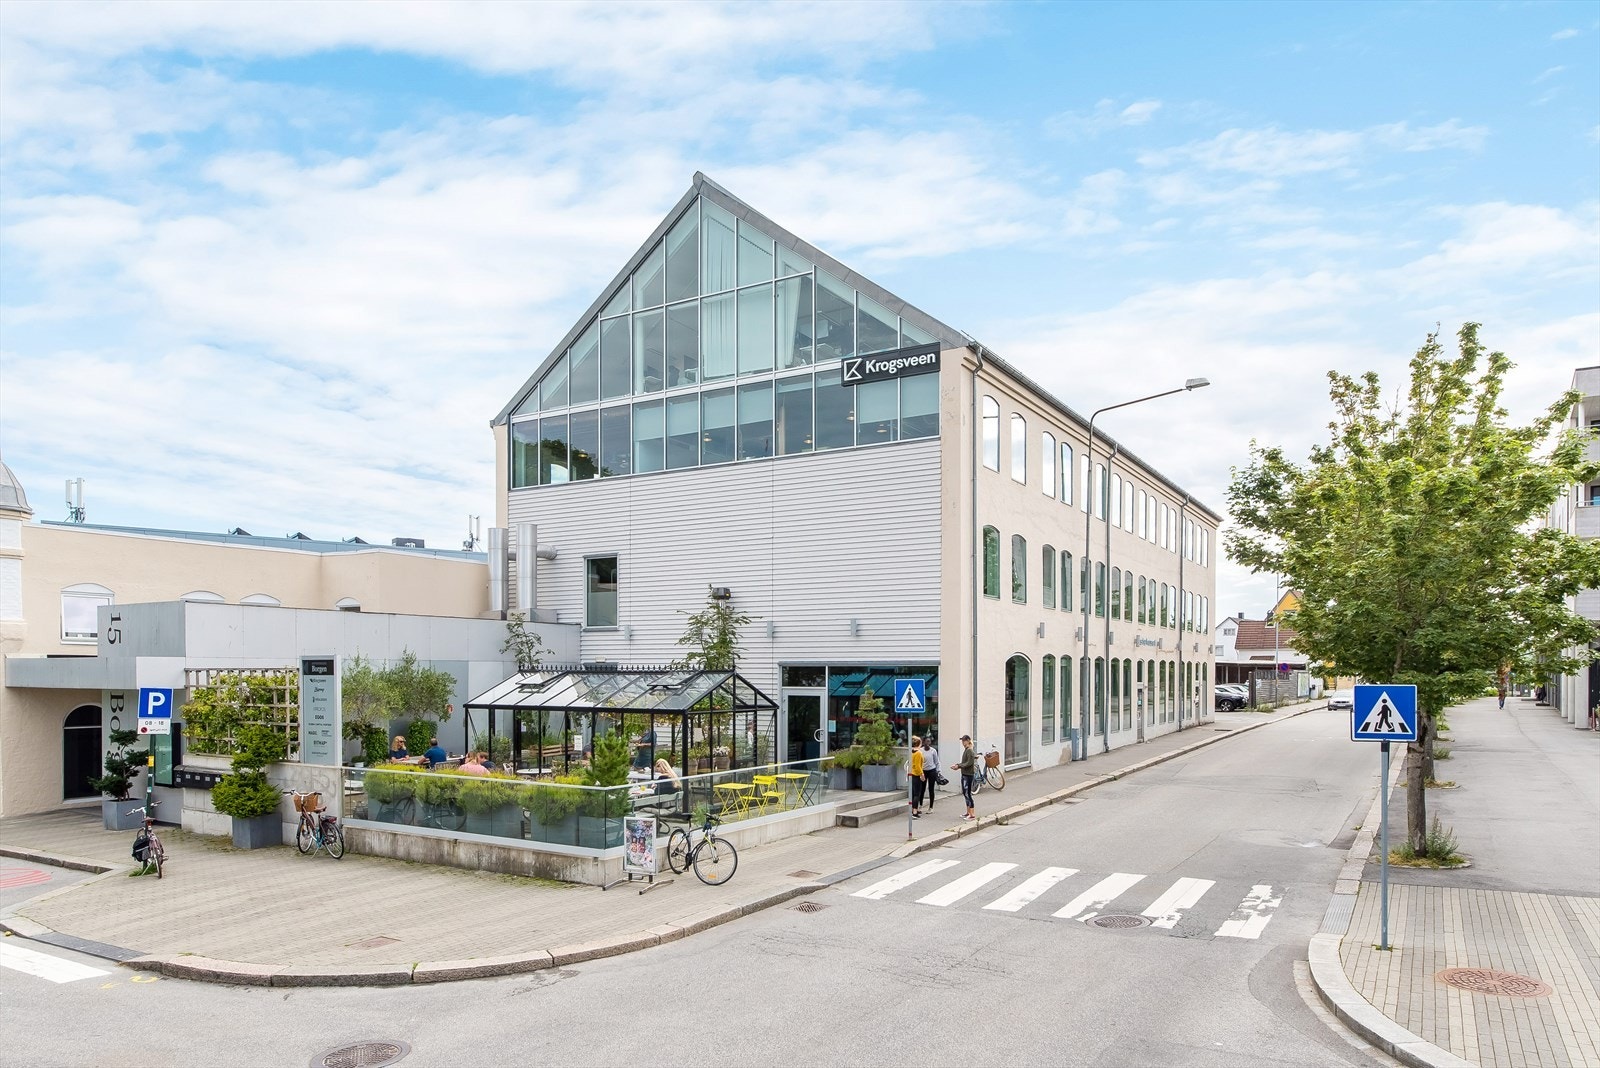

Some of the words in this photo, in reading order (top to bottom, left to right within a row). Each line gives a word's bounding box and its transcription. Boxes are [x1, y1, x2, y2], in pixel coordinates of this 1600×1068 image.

[865, 353, 936, 374] Krogsveen
[107, 612, 122, 645] 15
[147, 692, 166, 715] P
